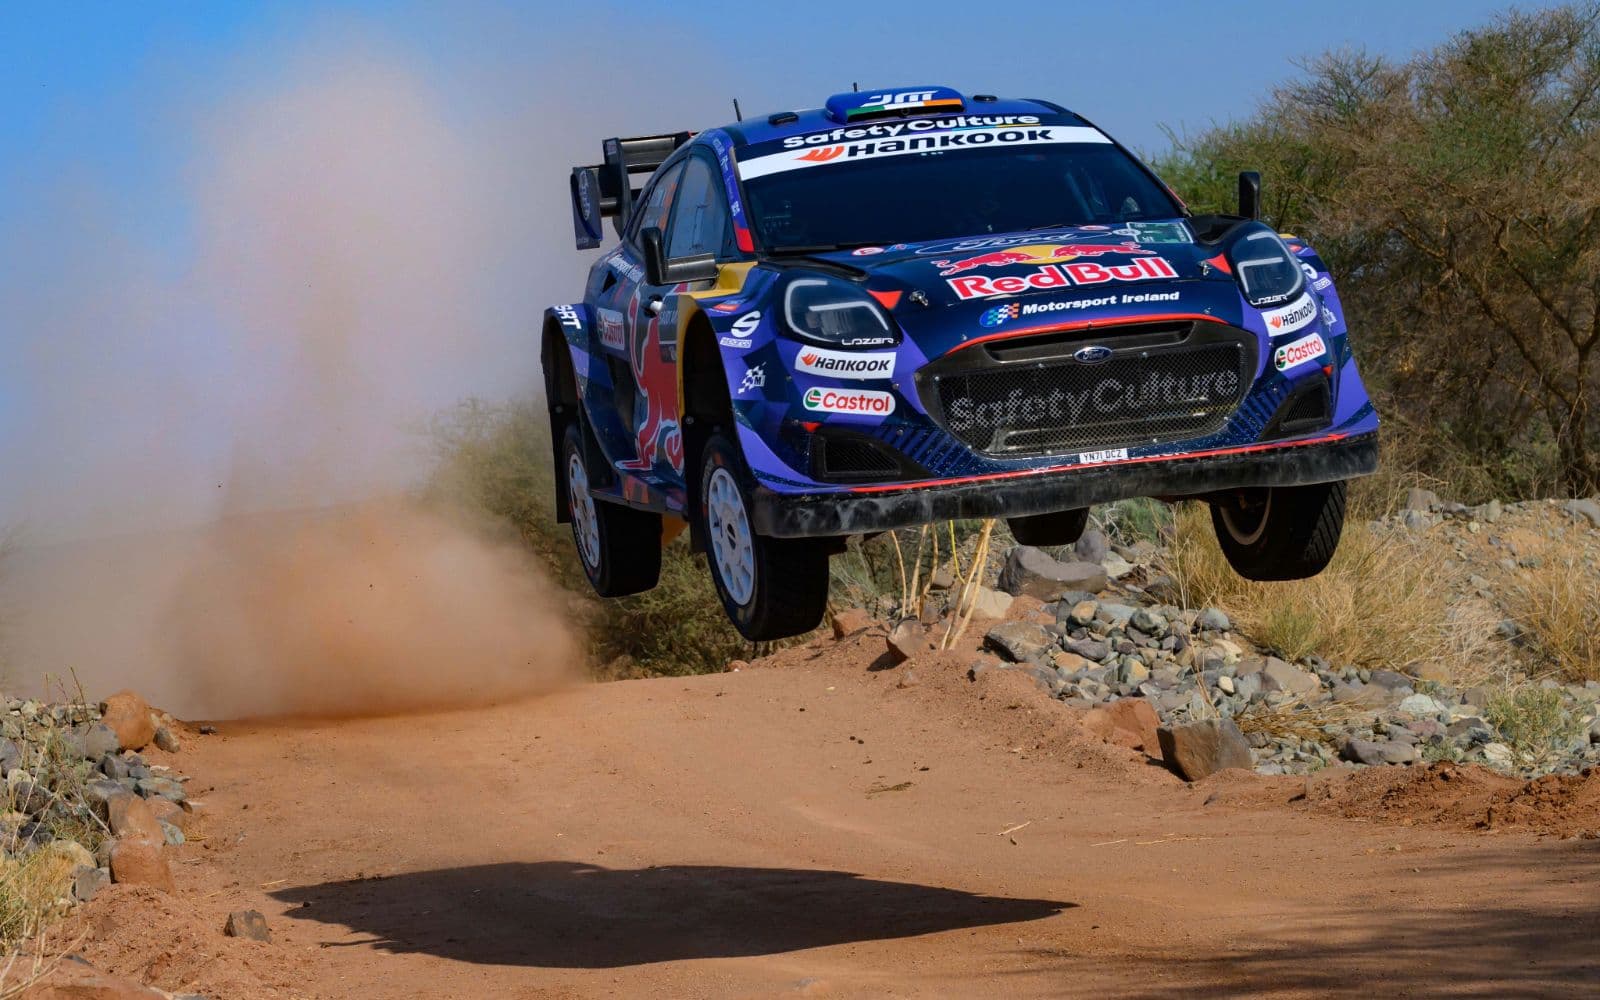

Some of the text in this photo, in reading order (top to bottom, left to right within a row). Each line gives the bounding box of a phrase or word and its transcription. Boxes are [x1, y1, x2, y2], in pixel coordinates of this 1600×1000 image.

[783, 114, 1041, 149] SafetyCulture
[950, 256, 1178, 300] Red Bull
[1022, 291, 1180, 315] Motorsport Ireland
[1286, 336, 1325, 364] Castrol
[822, 391, 890, 412] Castrol
[950, 369, 1240, 433] SafetyCulture
